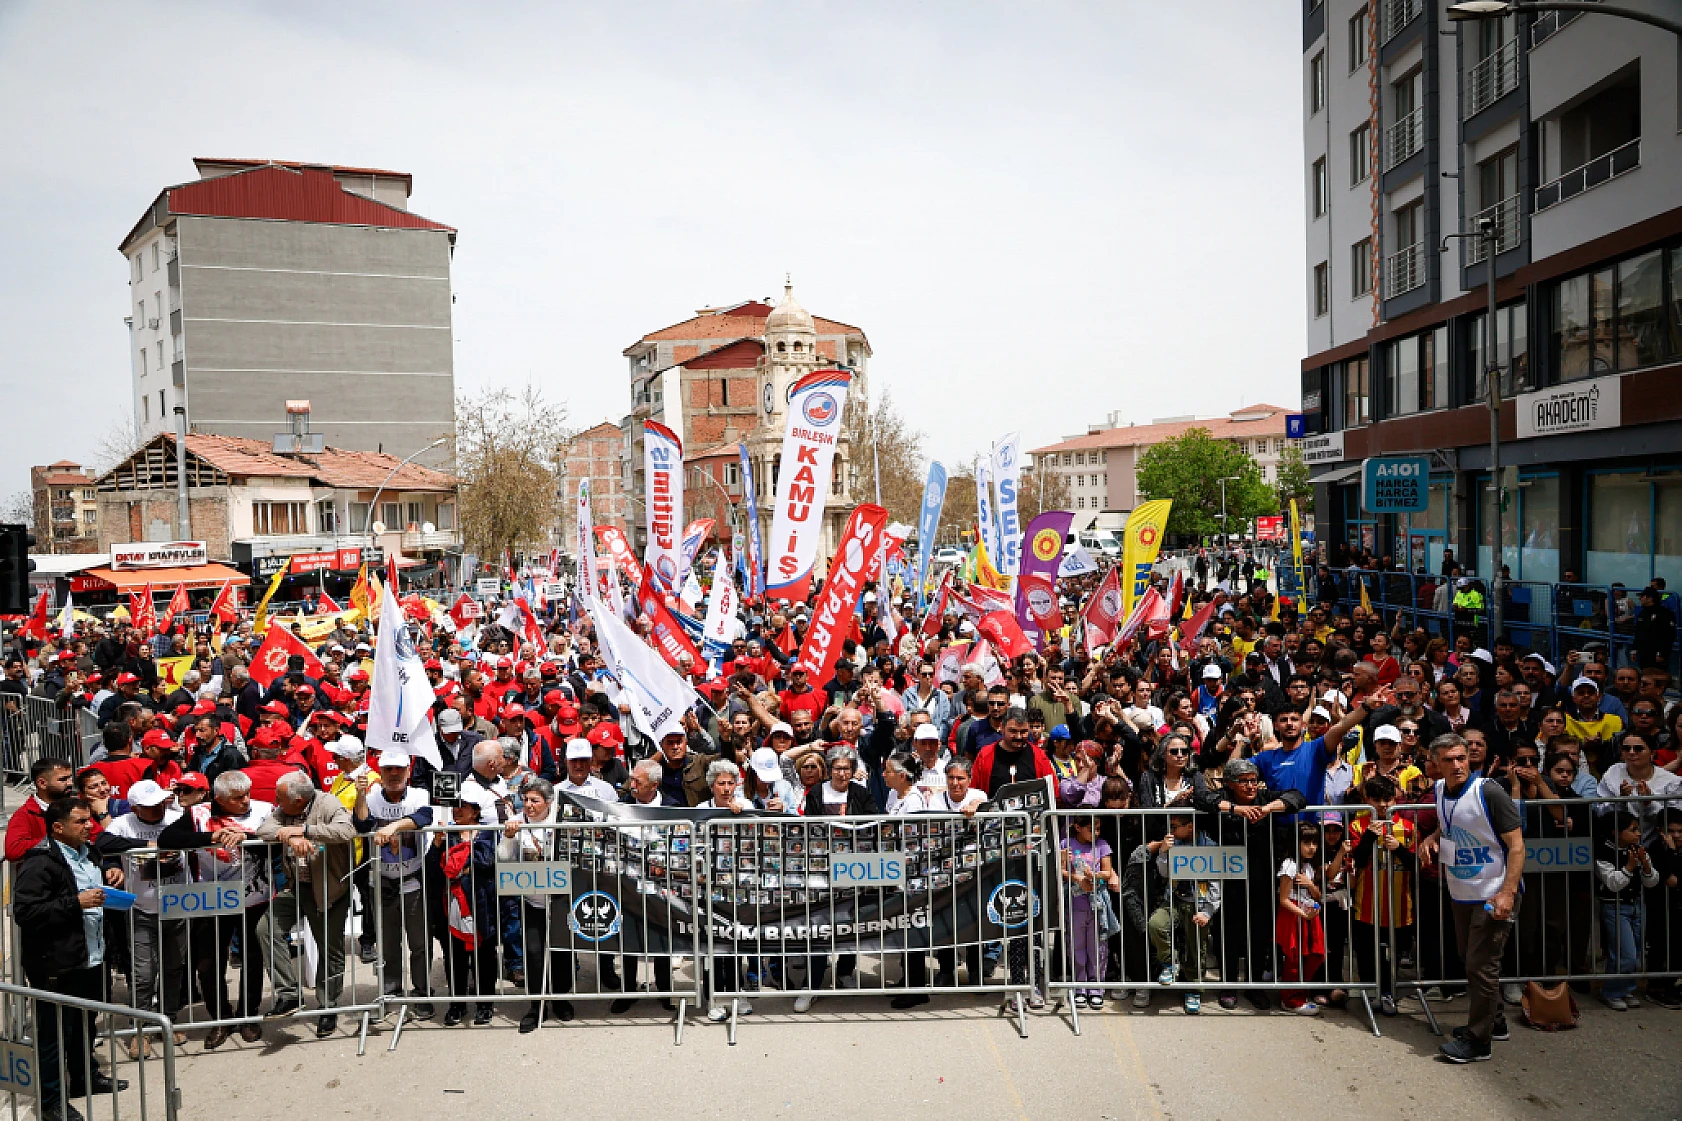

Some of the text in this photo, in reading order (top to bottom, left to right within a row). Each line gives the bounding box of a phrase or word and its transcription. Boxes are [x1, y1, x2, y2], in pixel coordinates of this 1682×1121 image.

[791, 427, 834, 446] BİRLEŞİK
[1376, 479, 1419, 488] HARCA
[1376, 488, 1419, 498] HARCA
[778, 445, 819, 579] KAMU İŞ
[1000, 479, 1017, 566] SES
[833, 857, 901, 882] POLİS
[1173, 851, 1245, 874] POLİS
[499, 866, 567, 889] POLİS
[161, 886, 239, 913] POLİS
[764, 924, 833, 940] BARIŞ
[0, 1050, 32, 1087] LİS
